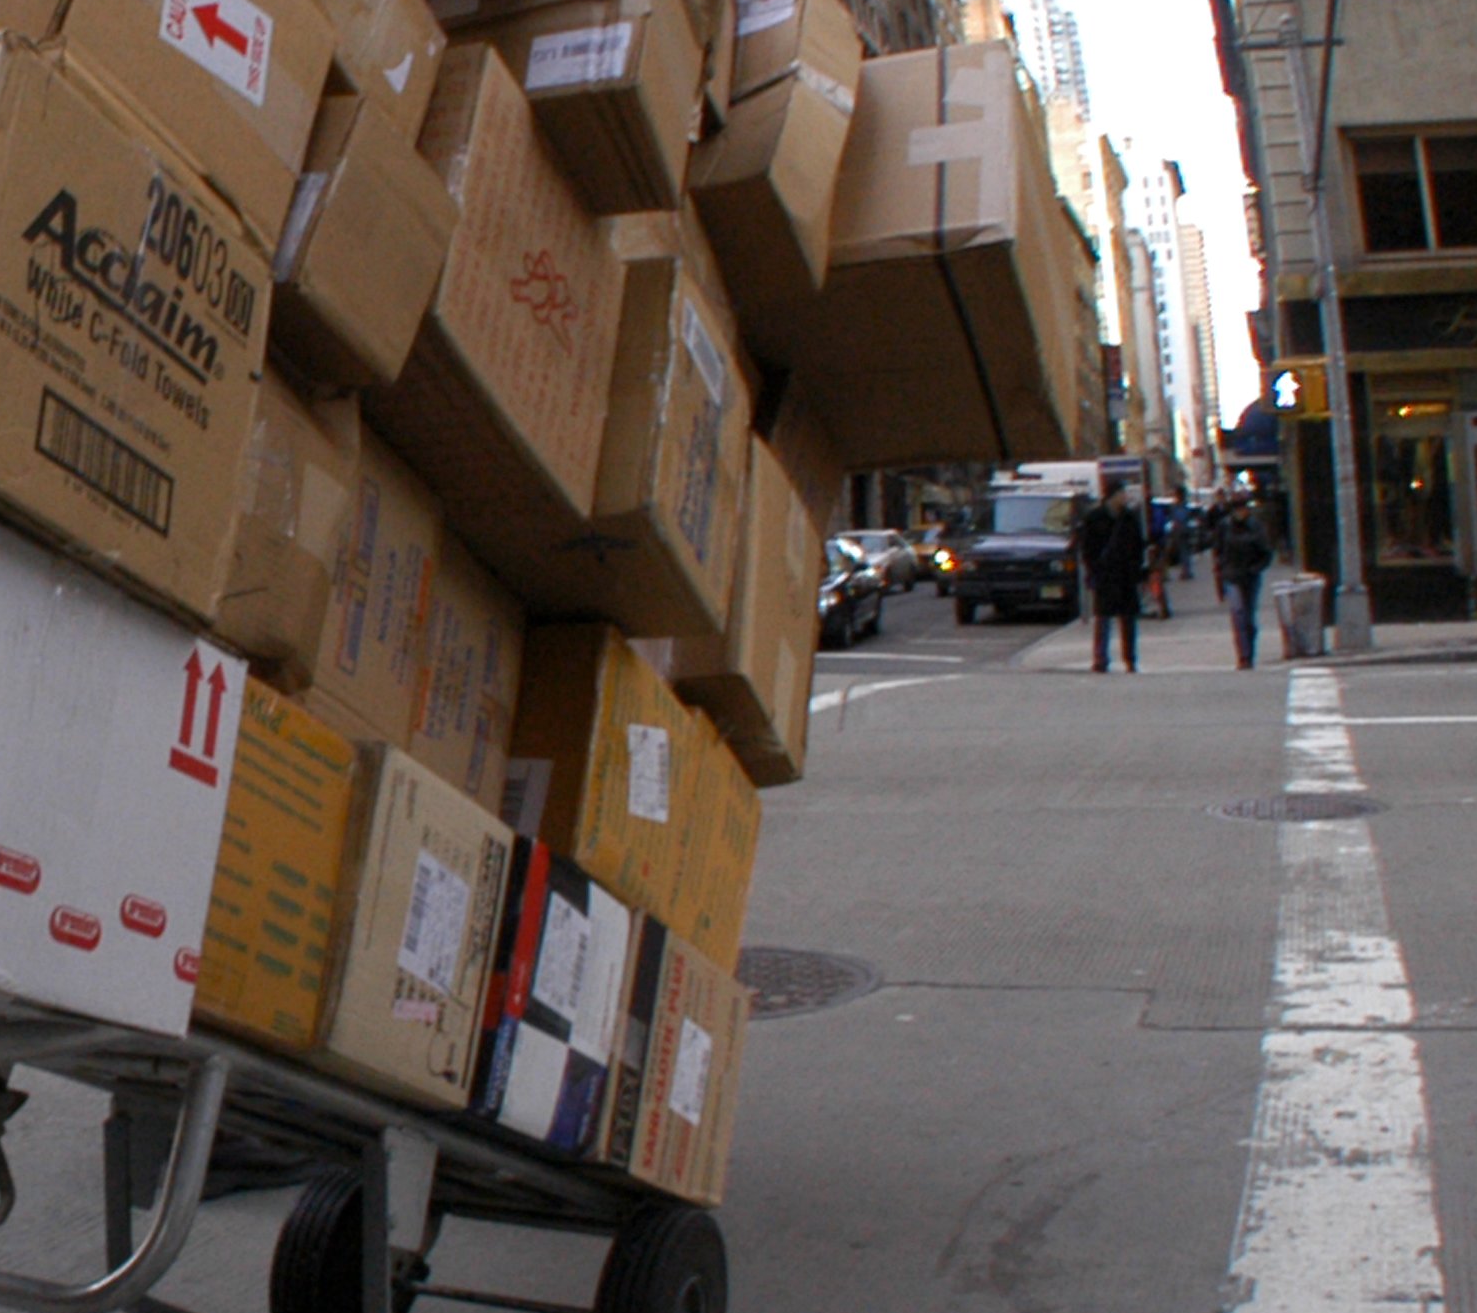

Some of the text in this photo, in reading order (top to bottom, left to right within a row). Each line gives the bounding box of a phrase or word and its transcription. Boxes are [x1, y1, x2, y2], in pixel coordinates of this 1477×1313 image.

[146, 173, 228, 309] 20603
[26, 255, 84, 329] White
[89, 310, 148, 382] C-Fold
[154, 360, 211, 431] Towels
